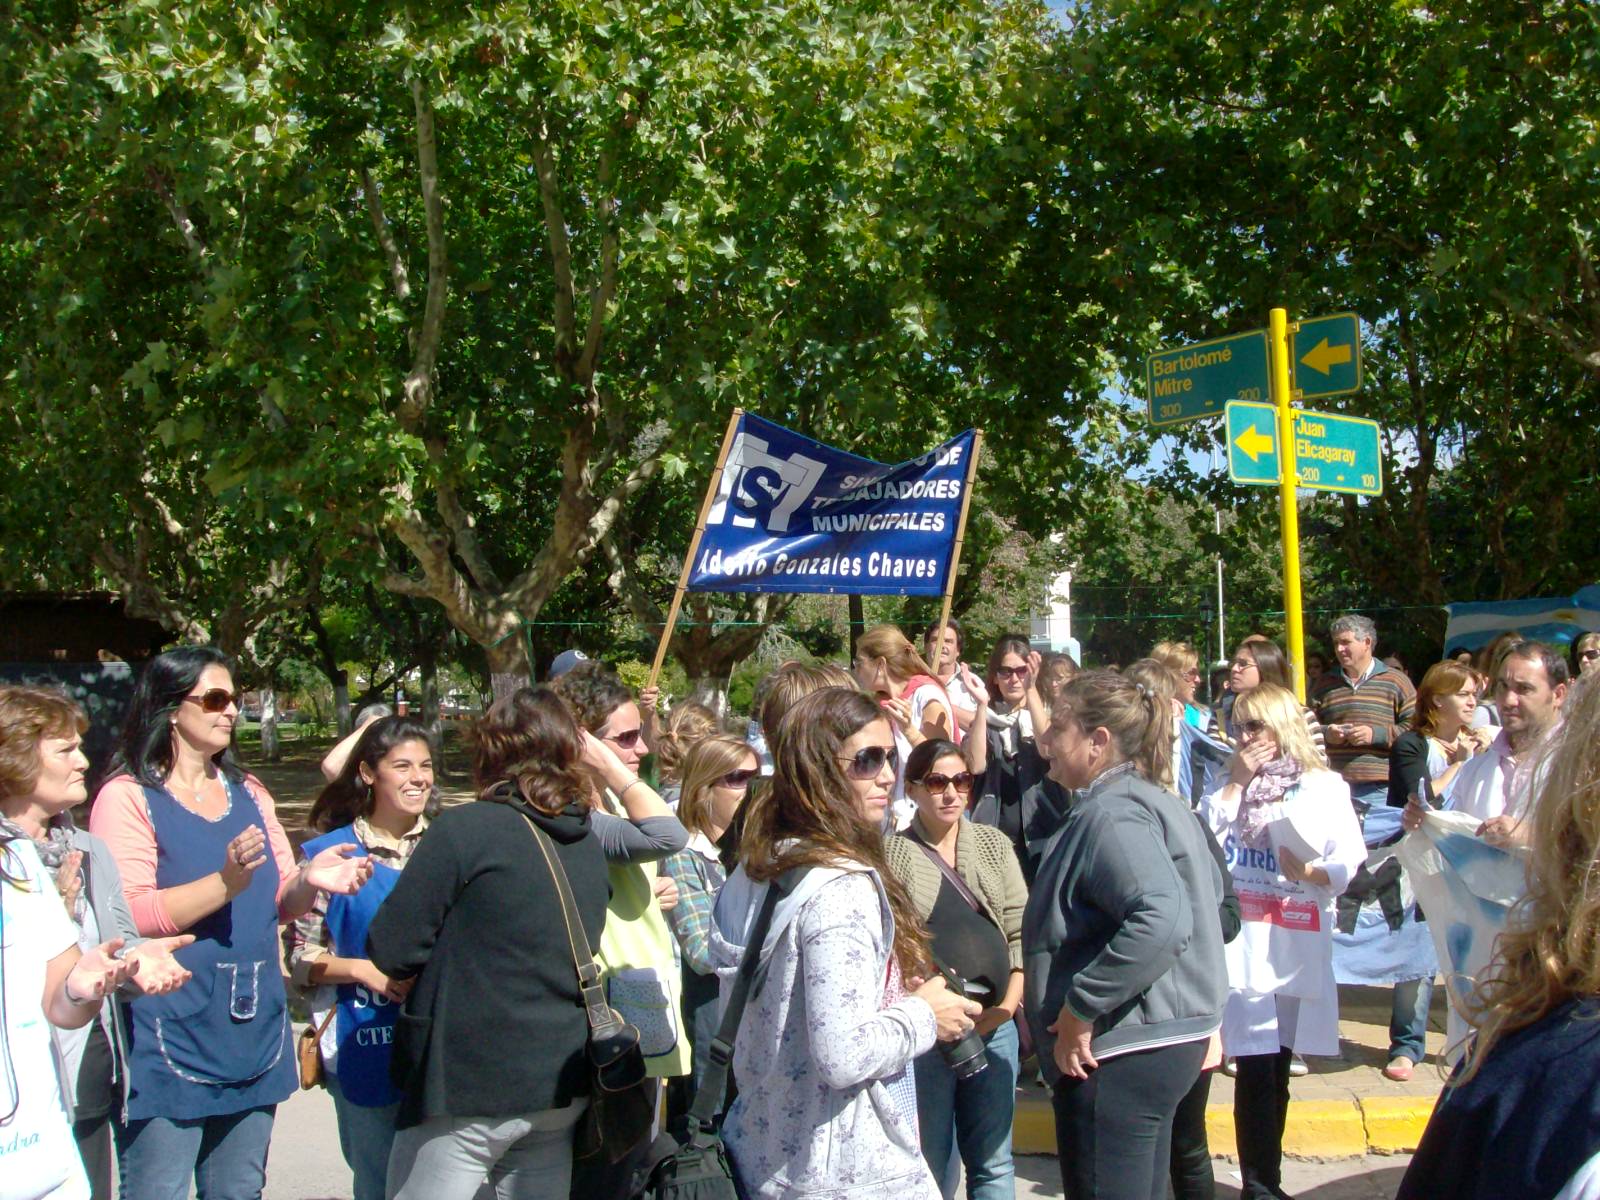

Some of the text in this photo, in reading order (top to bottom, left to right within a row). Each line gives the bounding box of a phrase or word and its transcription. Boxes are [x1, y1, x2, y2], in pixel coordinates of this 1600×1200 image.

[1153, 345, 1232, 377] Bartolomé
[1154, 378, 1193, 397] Mitre
[1160, 403, 1182, 418] 300
[1297, 418, 1326, 437] Juan
[1297, 439, 1355, 467] Elicagaray
[1302, 467, 1319, 481] 200
[1362, 474, 1375, 487] 100
[812, 512, 946, 533] MUNICIPALES
[773, 552, 862, 577] Gonzales
[868, 551, 937, 578] Chaves
